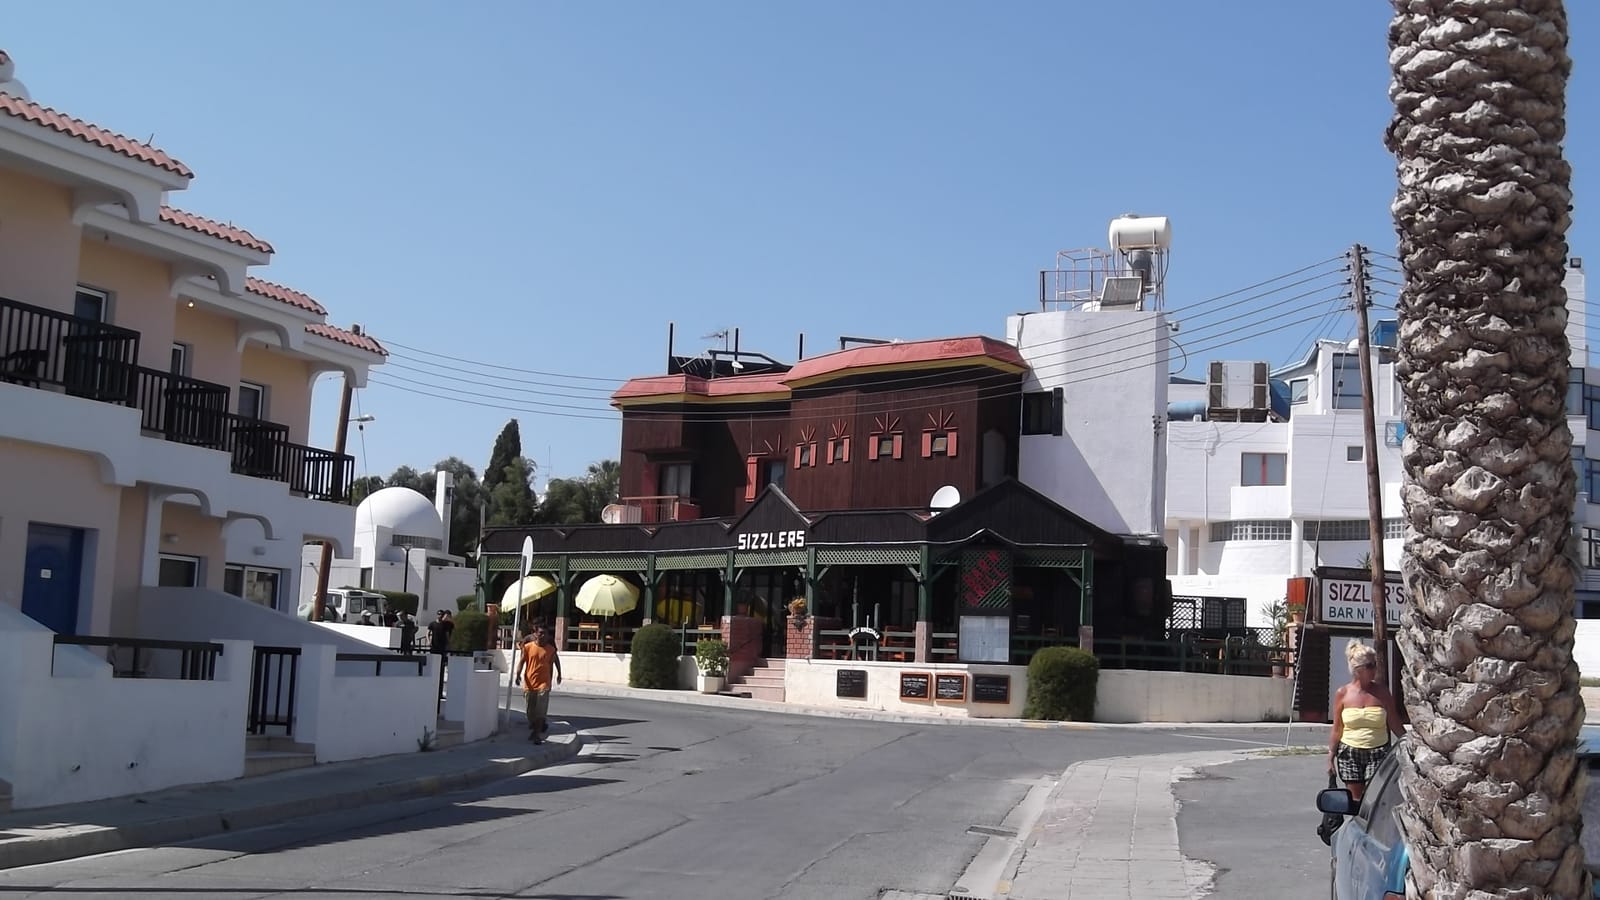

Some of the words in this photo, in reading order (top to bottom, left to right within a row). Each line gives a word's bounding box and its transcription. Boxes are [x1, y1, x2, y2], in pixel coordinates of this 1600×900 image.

[738, 530, 805, 550] SIZZLERS
[1329, 582, 1405, 605] SIZZLR'S
[1328, 606, 1353, 619] BAR
[1357, 607, 1368, 619] N'
